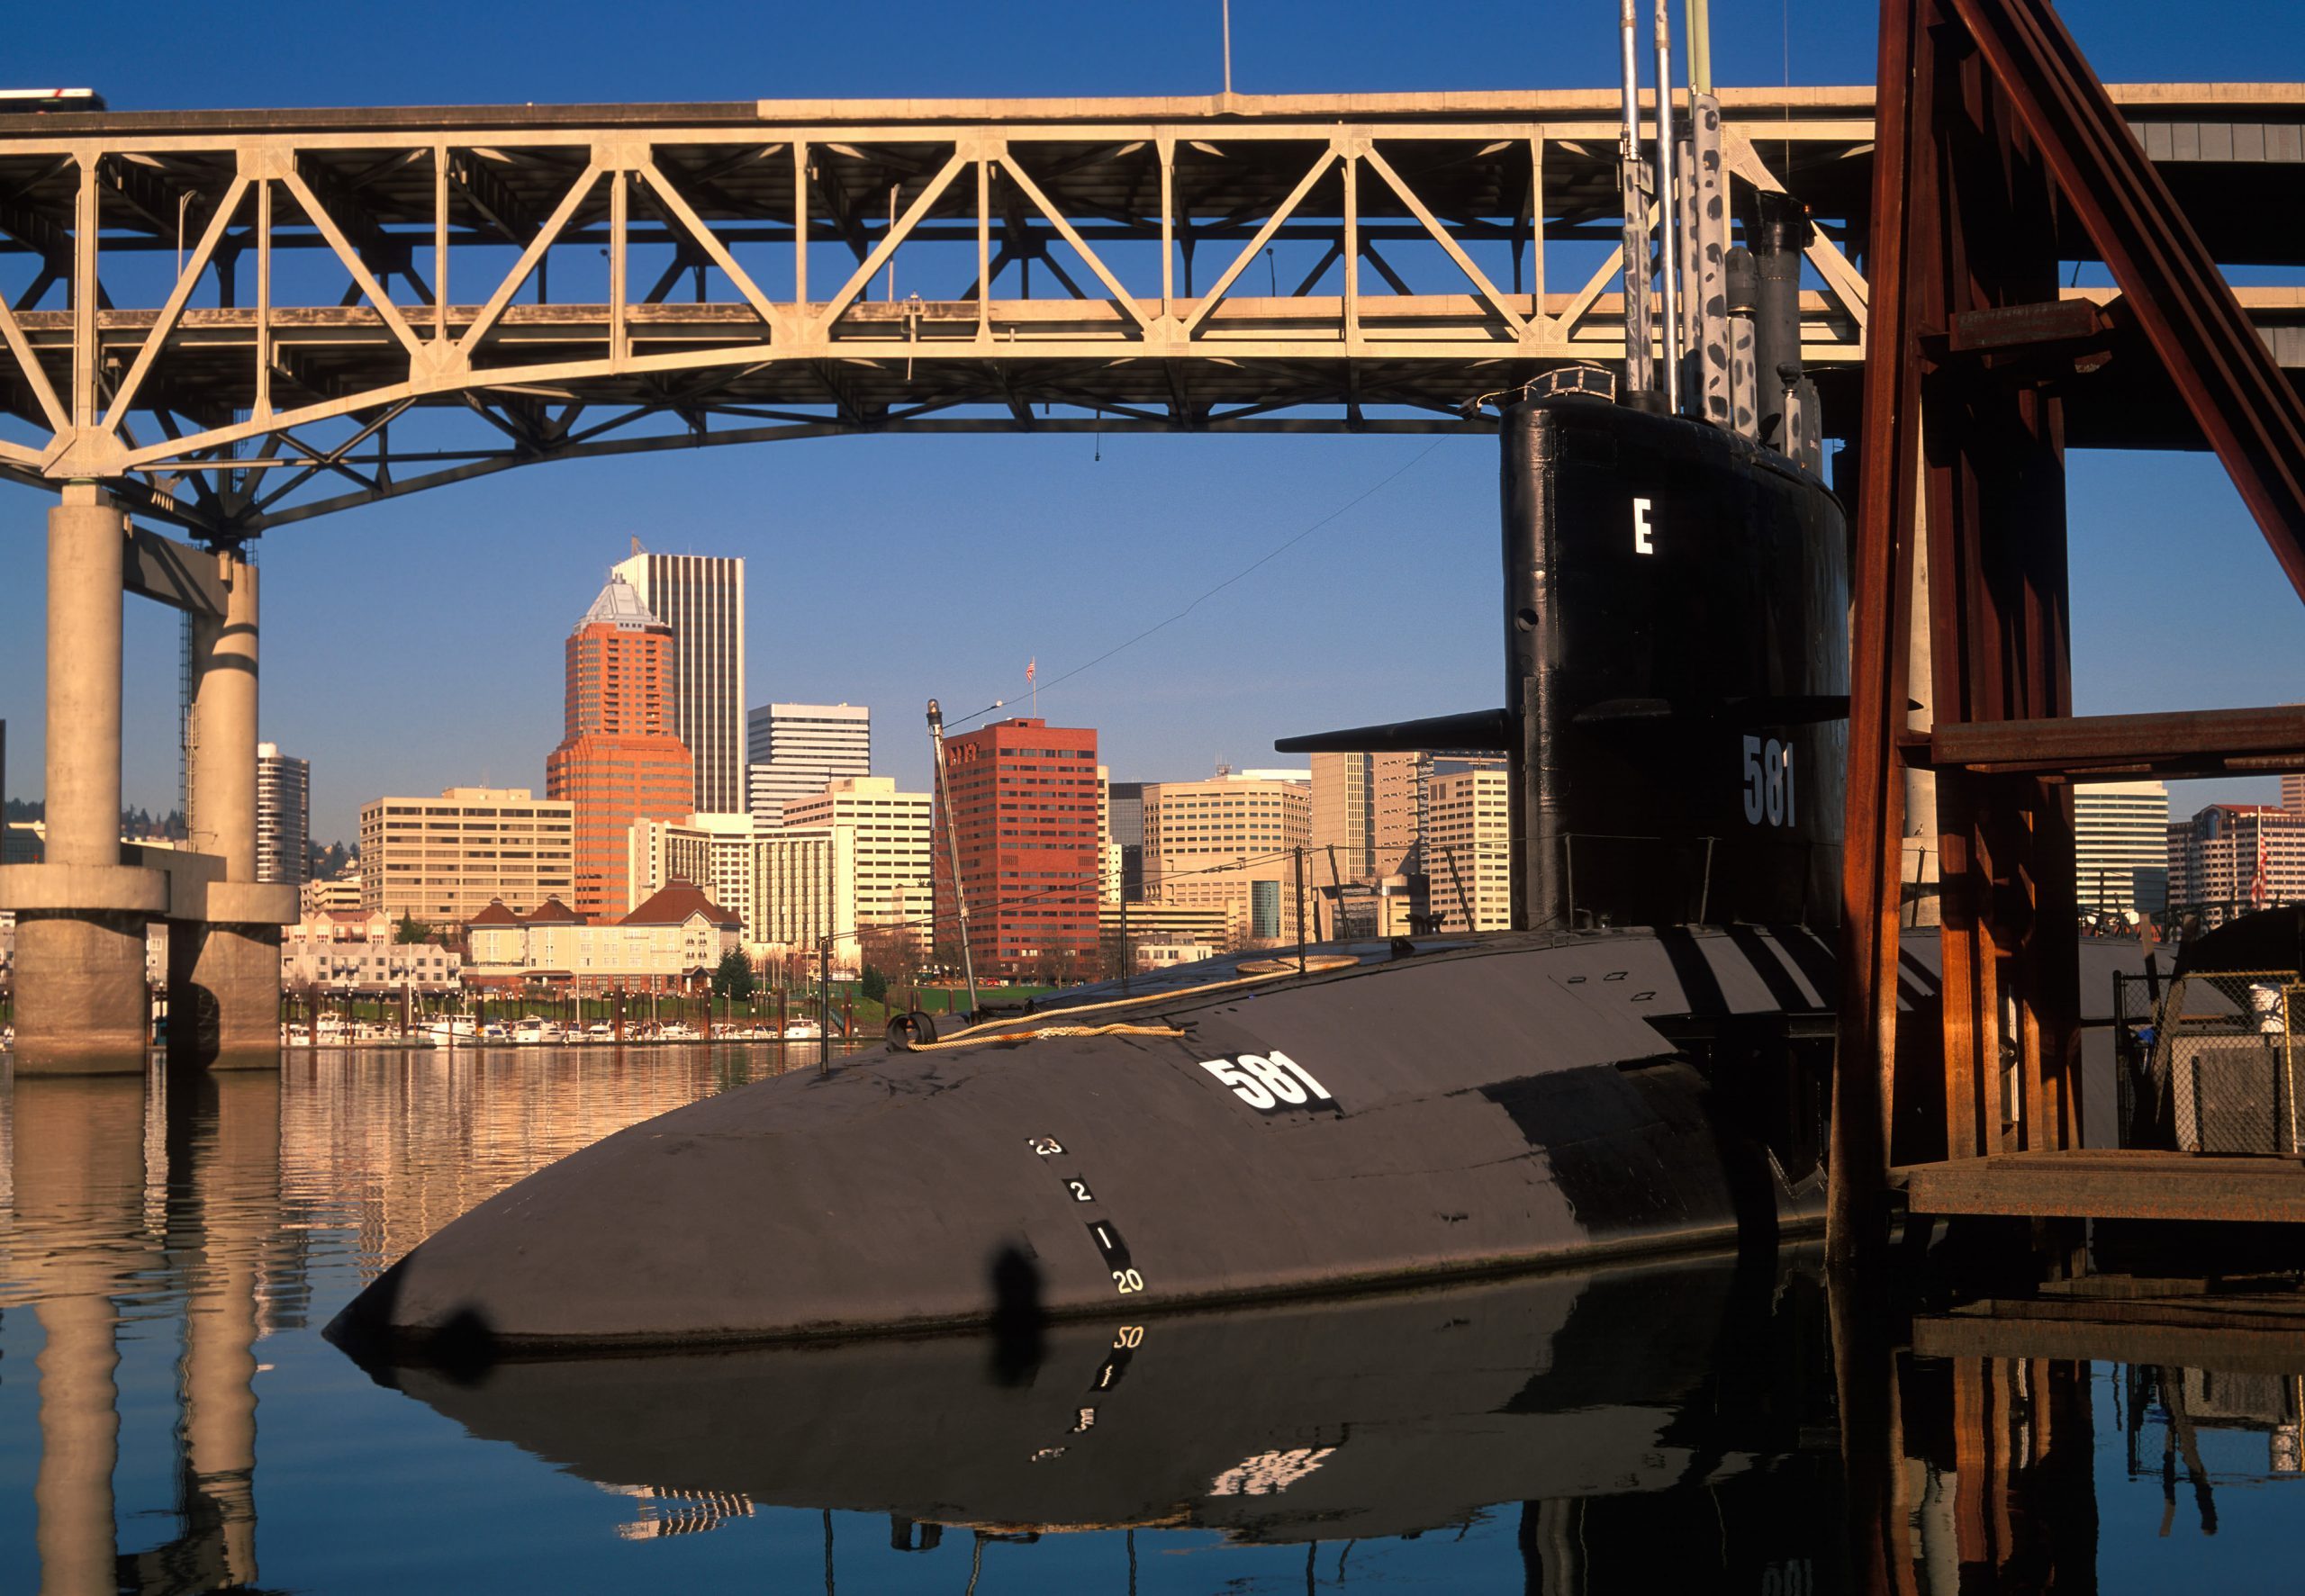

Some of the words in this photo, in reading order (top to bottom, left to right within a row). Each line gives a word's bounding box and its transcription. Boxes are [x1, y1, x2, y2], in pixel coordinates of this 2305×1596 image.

[1633, 498, 1653, 555] E
[1743, 735, 1794, 827] 581
[1198, 1050, 1332, 1109] 581
[1070, 1181, 1092, 1201] 2
[1112, 1268, 1143, 1294] 20
